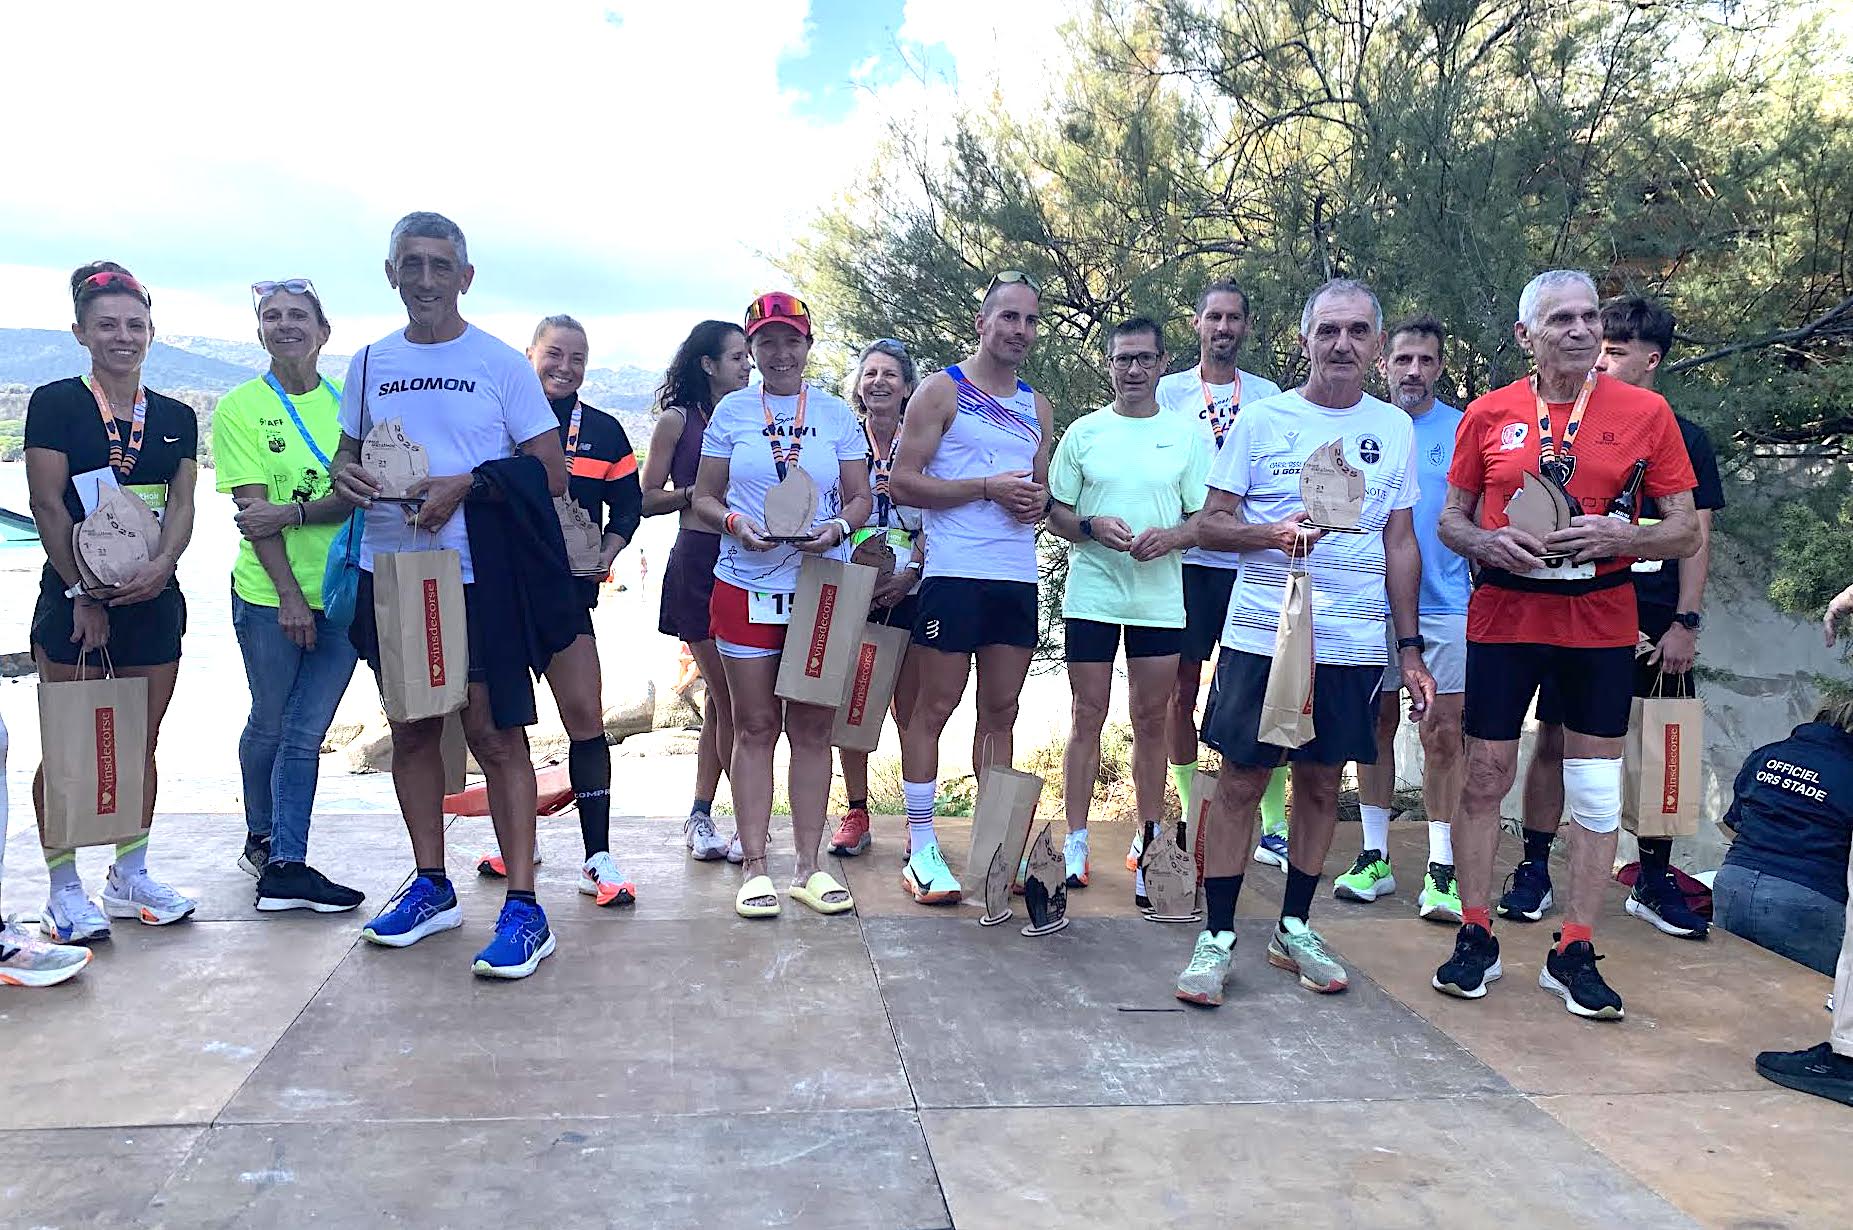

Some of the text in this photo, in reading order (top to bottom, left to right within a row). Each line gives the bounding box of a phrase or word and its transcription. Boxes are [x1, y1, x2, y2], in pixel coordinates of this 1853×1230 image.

[378, 377, 476, 396] SALOMON
[1334, 448, 1358, 478] 2025
[106, 512, 136, 538] 2025
[418, 583, 441, 662] vinsdecorse
[813, 588, 835, 659] vinsdecorse
[855, 646, 875, 708] vinsdecorse
[101, 713, 114, 791] vinsdecorse
[1668, 728, 1678, 794] vinsdecorse
[1766, 759, 1820, 784] OFFICIEL
[1756, 770, 1828, 802] ORS STADE
